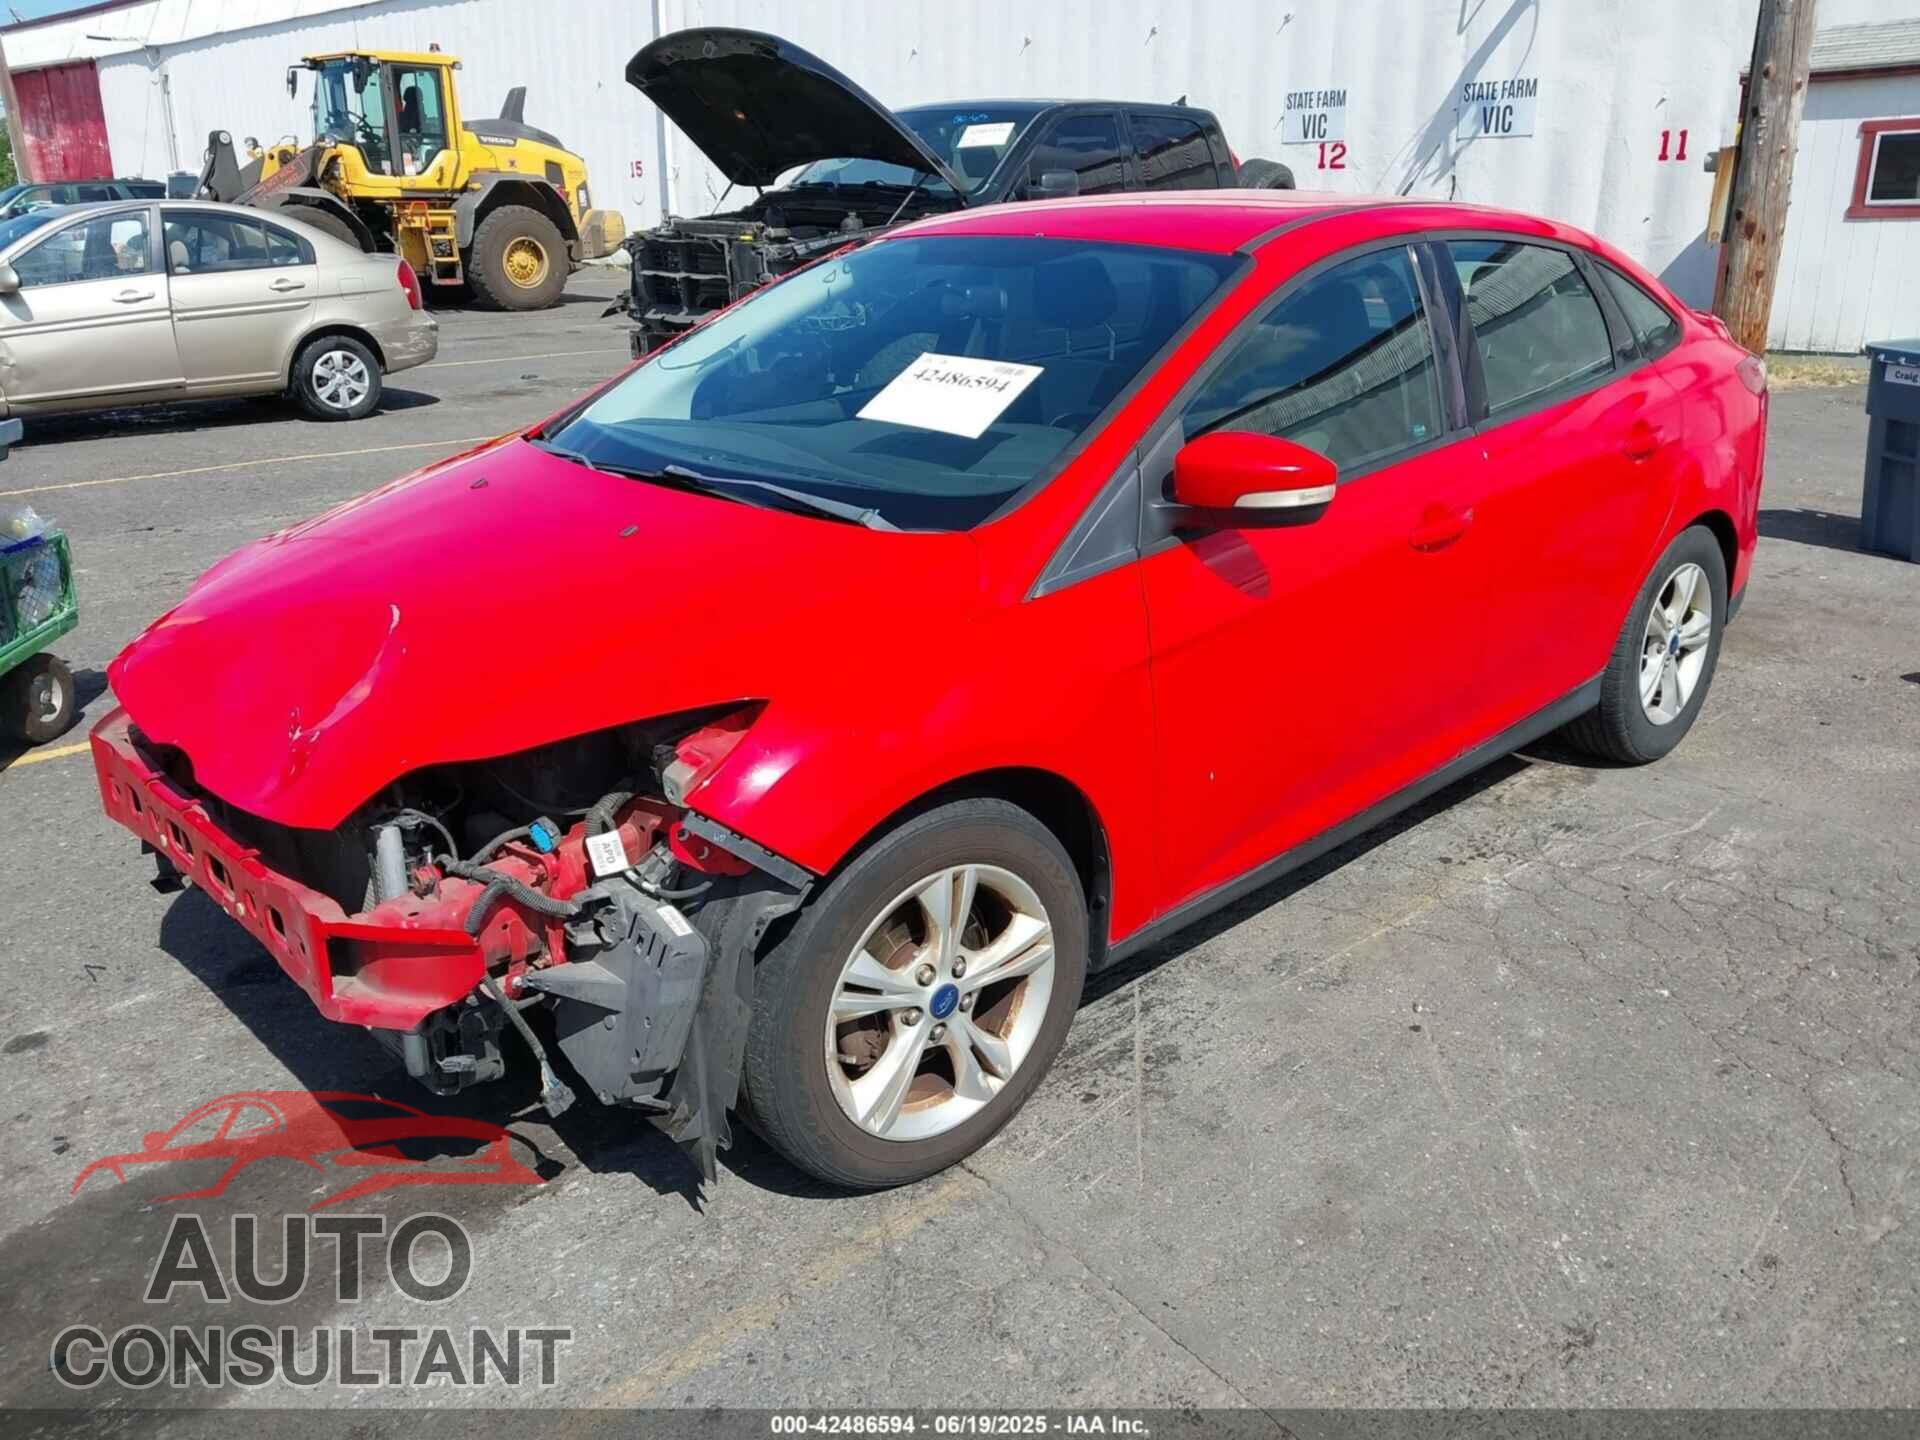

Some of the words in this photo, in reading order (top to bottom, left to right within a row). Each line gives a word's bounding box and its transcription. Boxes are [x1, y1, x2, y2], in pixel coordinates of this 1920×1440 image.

[1286, 91, 1314, 110] STATE
[1316, 89, 1346, 108] FARM
[1463, 81, 1498, 102] STATE
[1501, 77, 1537, 99] FARM
[1302, 113, 1328, 139] VIC
[1482, 104, 1513, 134] VIC
[1317, 142, 1347, 169] 12
[1658, 129, 1688, 161] 11
[630, 160, 644, 179] 15
[912, 367, 1012, 393] 42486594
